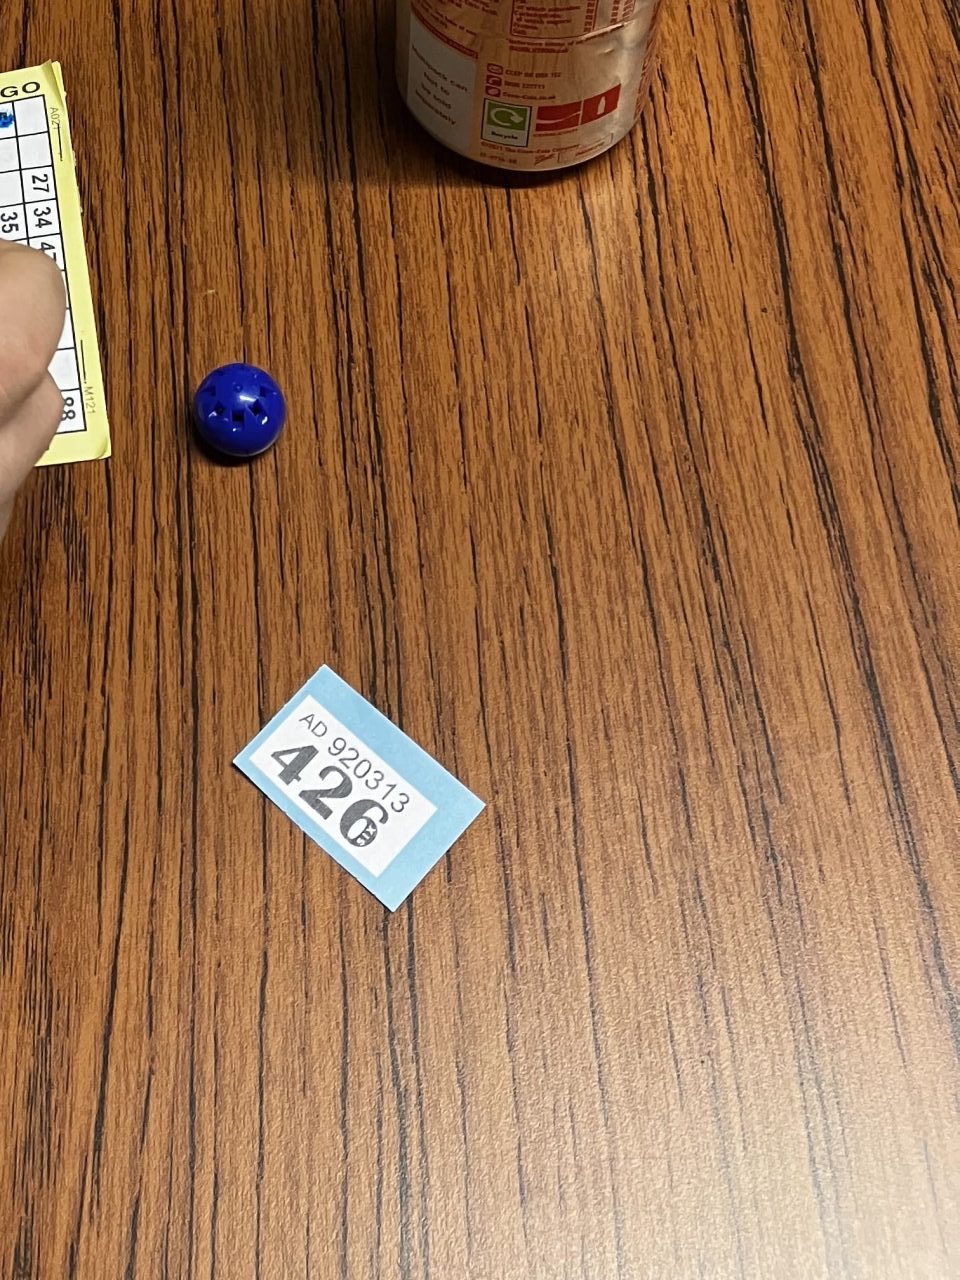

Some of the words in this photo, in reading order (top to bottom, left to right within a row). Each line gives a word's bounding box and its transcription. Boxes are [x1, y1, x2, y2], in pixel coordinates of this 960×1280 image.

[50, 107, 61, 130] A021
[31, 174, 50, 193] 27
[0, 212, 19, 234] 35
[34, 207, 52, 228] 34
[298, 713, 328, 738] AD
[328, 737, 410, 813] 920313
[271, 744, 389, 848] 426
